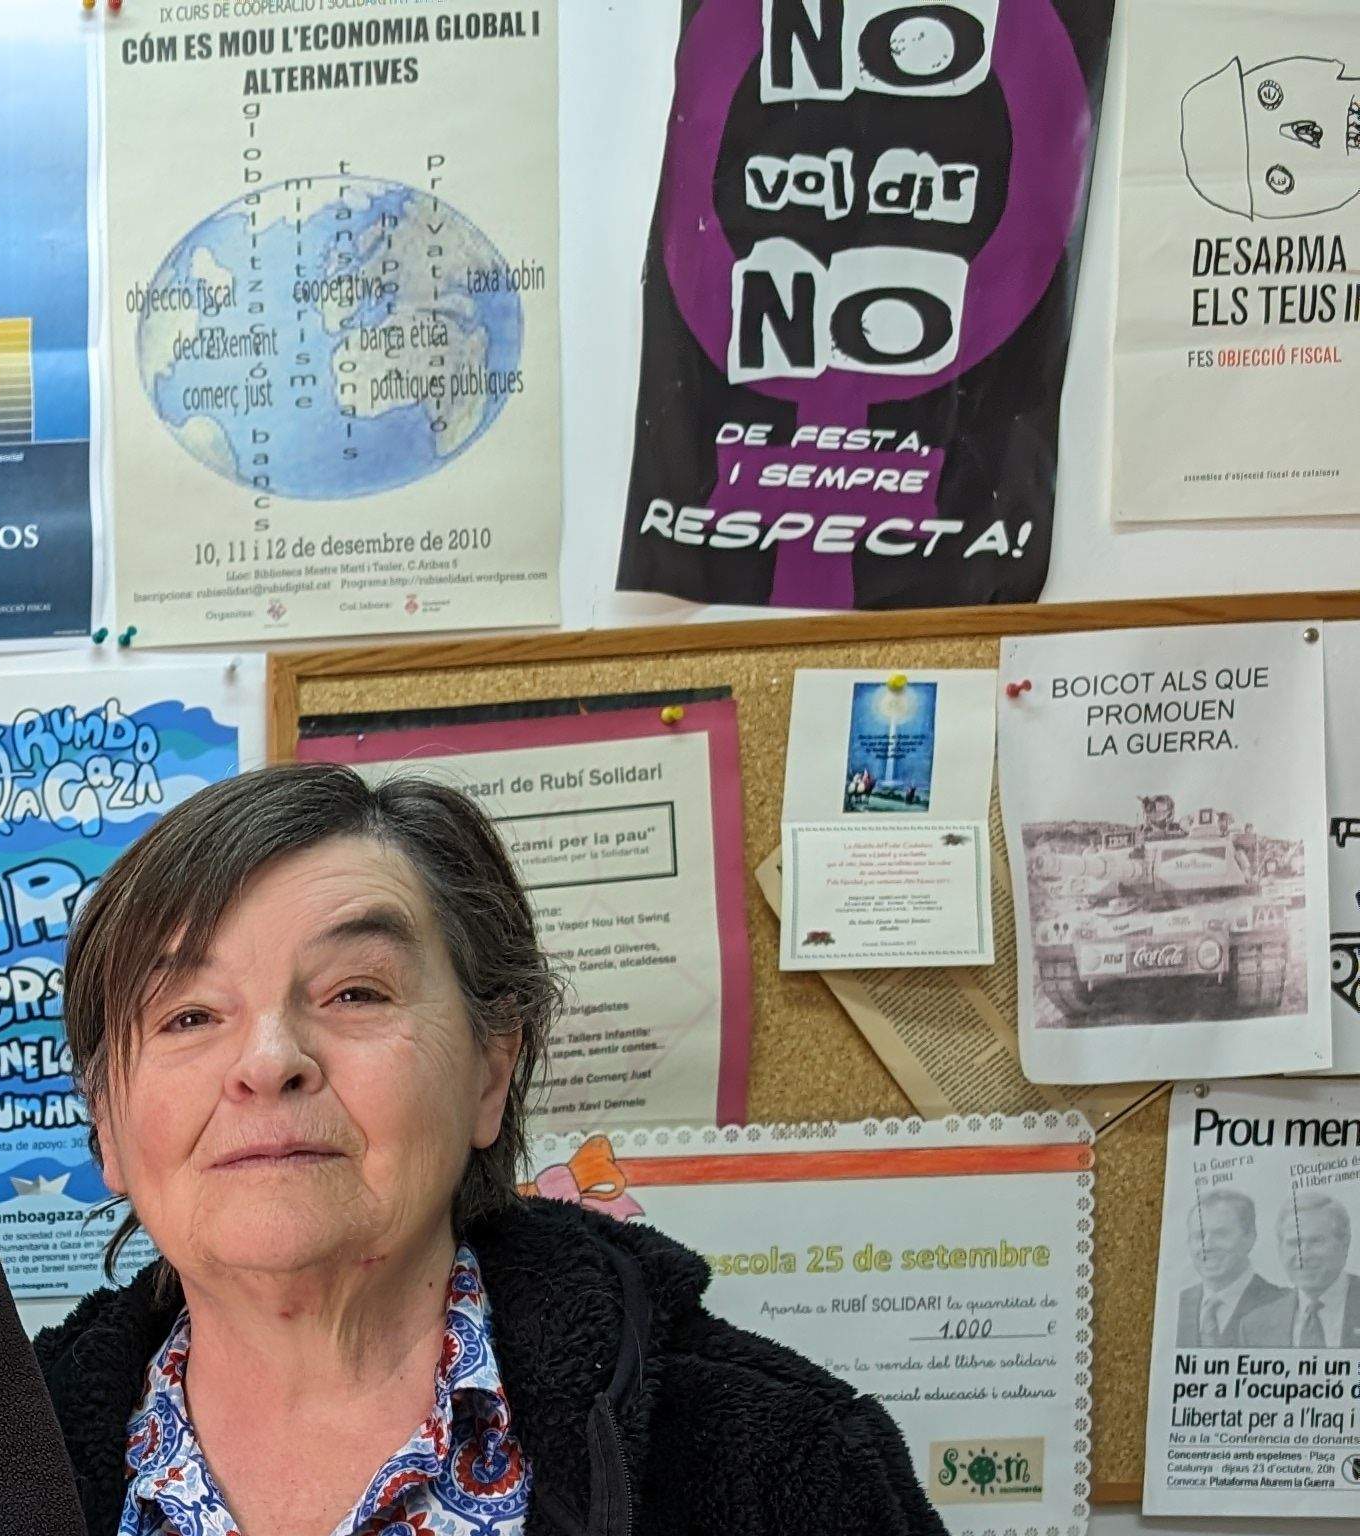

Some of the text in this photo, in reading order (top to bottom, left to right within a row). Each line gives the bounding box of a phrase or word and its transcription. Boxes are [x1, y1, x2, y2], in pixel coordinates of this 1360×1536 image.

[176, 5, 210, 21] CURS
[213, 2, 231, 18] DE
[122, 10, 541, 65] CÓM ES MOU L'ECONOMIA GLOBAL I
[766, 0, 988, 96] NO
[242, 56, 419, 96] ALTERNATIVES
[746, 150, 977, 215] vol dir
[1192, 234, 1348, 278] DESARMA
[466, 259, 546, 294] taxa tobin
[126, 277, 237, 320] objecció fiscal
[1191, 286, 1249, 327] ELS
[1257, 283, 1337, 325] TEUS
[735, 268, 956, 371] NO
[1187, 344, 1342, 368] FES OBJECCIÓ FISCAL
[182, 377, 274, 417] comerç just
[450, 362, 525, 407] públiques
[716, 422, 932, 458] DE FESTA,
[729, 462, 929, 494] I SEMPRE
[640, 499, 1033, 561] RESPECTA!
[194, 541, 221, 566] 10,
[226, 539, 247, 562] 11
[266, 536, 286, 559] 12
[291, 534, 315, 558] de
[320, 530, 414, 557] desembre
[419, 529, 443, 552] de
[447, 528, 492, 551] 2010
[1050, 666, 1270, 701] BOICOT ALS QUE
[1085, 699, 1236, 727] PROMOUEN
[1085, 729, 1240, 757] LA GUERRA.
[509, 762, 663, 794] de Rubí Solidari
[559, 833, 587, 852] per
[593, 831, 610, 846] la
[1193, 1107, 1360, 1148] Prou men
[16, 1139, 28, 1151] de
[32, 1139, 68, 1153] apoyo:
[1193, 1153, 1256, 1175] La Guerra
[1211, 1172, 1234, 1188] pau
[806, 1245, 844, 1274] 25
[852, 1242, 892, 1273] de
[900, 1239, 1051, 1271] setembre
[831, 1293, 868, 1313] RUBÍ
[871, 1296, 941, 1313] SOLIDARI
[946, 1296, 963, 1311] la
[966, 1296, 1037, 1316] quantitat
[1040, 1293, 1059, 1309] de
[938, 1317, 993, 1340] 1.000
[853, 1357, 871, 1373] la
[875, 1357, 924, 1372] venda
[927, 1355, 951, 1370] del
[954, 1354, 996, 1371] llibre
[999, 1352, 1057, 1369] solidari
[1174, 1353, 1197, 1376] Ni
[1203, 1359, 1230, 1376] un
[1236, 1353, 1291, 1379] Euro,
[1297, 1355, 1318, 1376] ni
[1323, 1359, 1351, 1376] un
[924, 1385, 989, 1401] educació
[1001, 1384, 1056, 1400] cultura
[1172, 1381, 1209, 1405] per
[1214, 1382, 1228, 1399] a
[1234, 1377, 1344, 1405] l'ocupació
[1171, 1406, 1243, 1428] Llibertat
[1248, 1411, 1278, 1434] per
[1283, 1412, 1294, 1428] a
[1300, 1406, 1344, 1435] l'Iraq
[1169, 1432, 1186, 1444] No
[1189, 1434, 1197, 1444] a
[1199, 1432, 1211, 1444] la
[1293, 1432, 1309, 1445] de
[1167, 1449, 1232, 1461] Concentració
[1232, 1450, 1255, 1461] amb
[1309, 1450, 1336, 1463] Plaça
[1167, 1462, 1214, 1475] Catalunya
[1251, 1463, 1265, 1474] 23
[1209, 1475, 1259, 1488] Plataforma
[1303, 1477, 1335, 1489] Guerra
